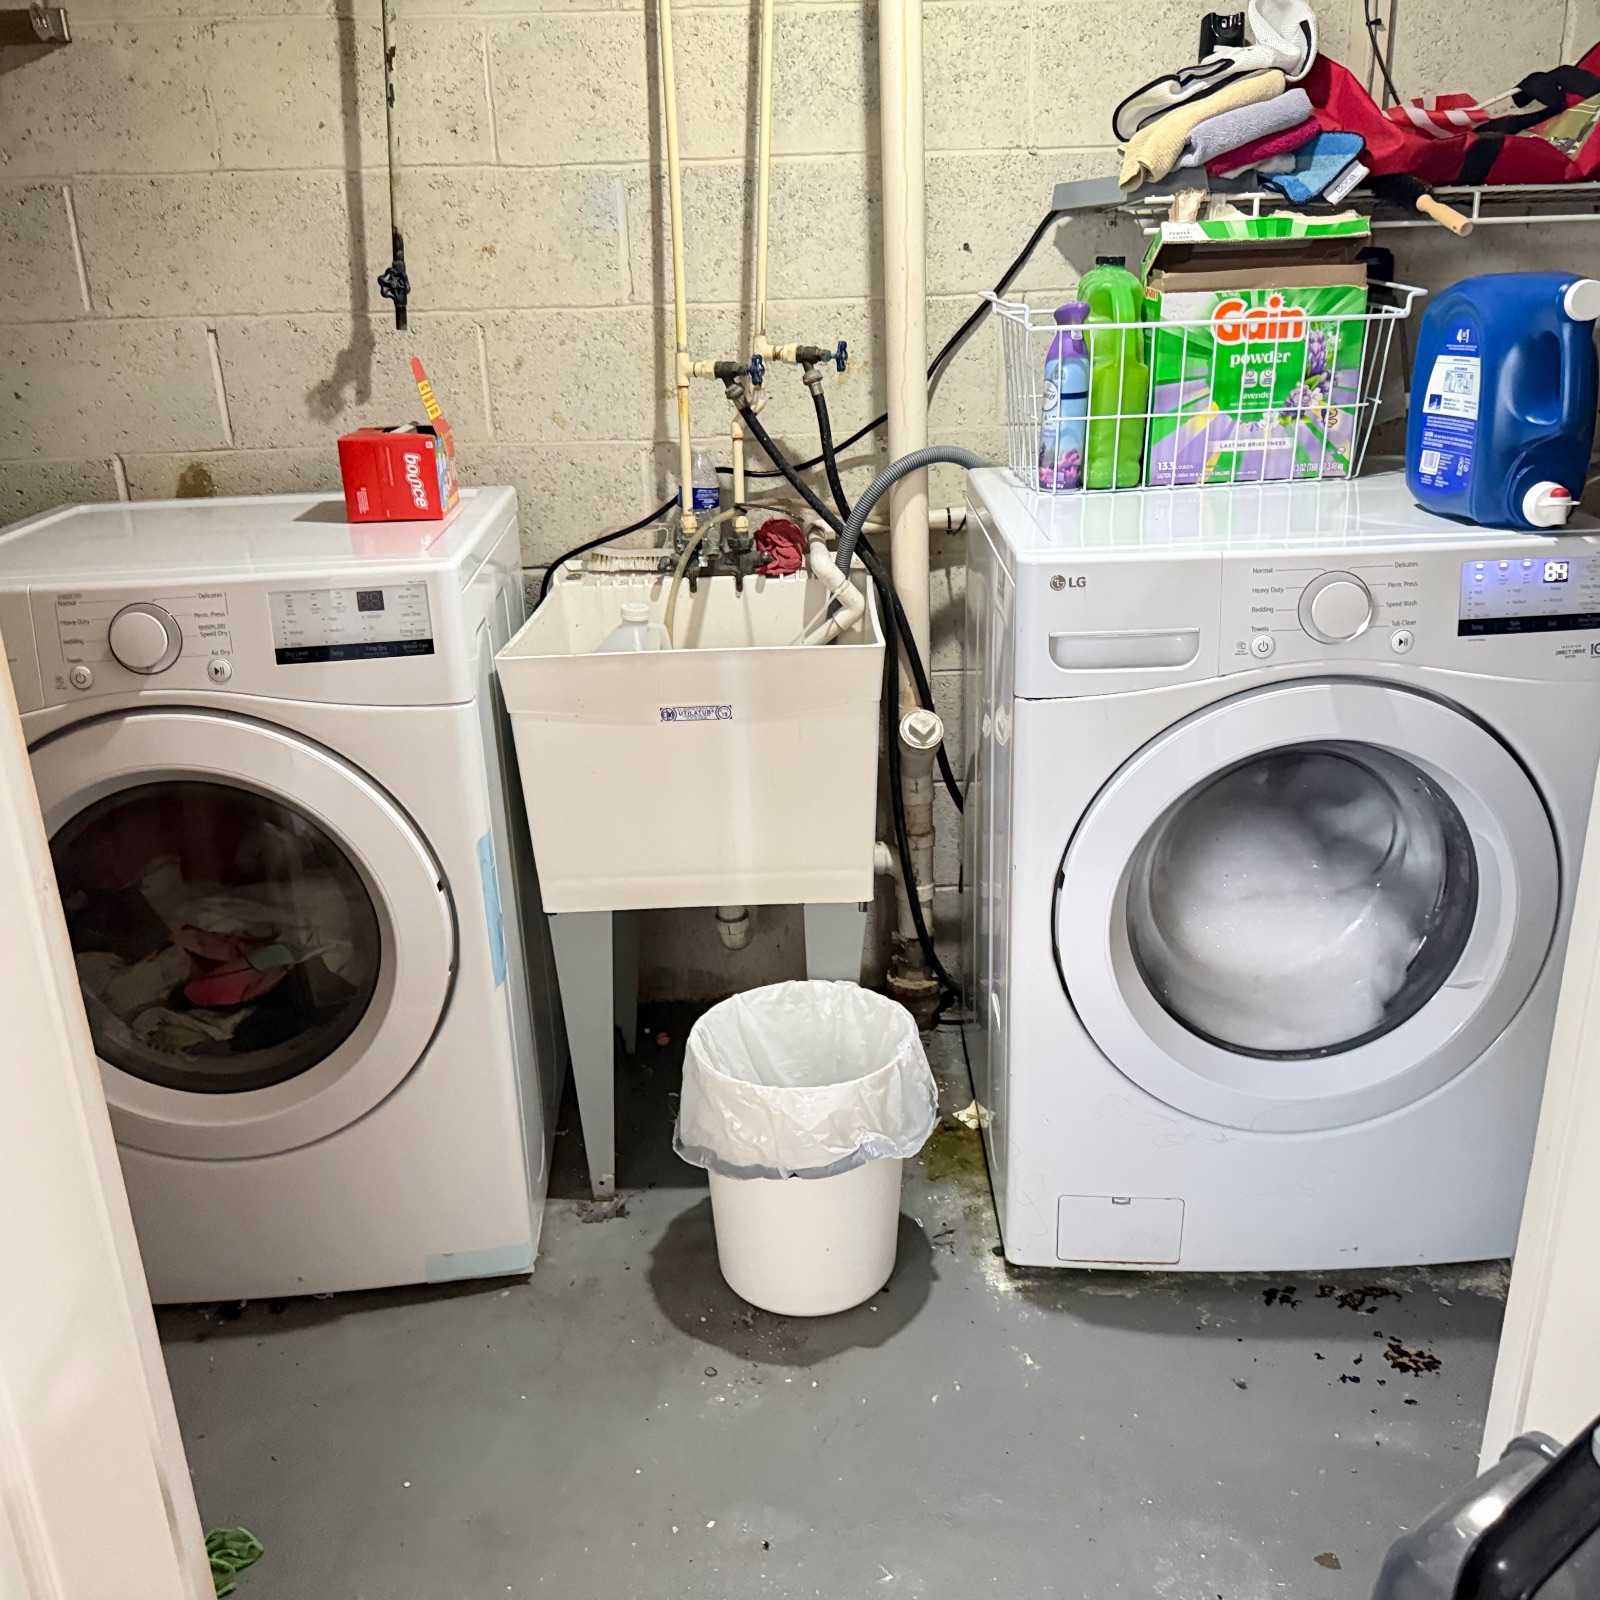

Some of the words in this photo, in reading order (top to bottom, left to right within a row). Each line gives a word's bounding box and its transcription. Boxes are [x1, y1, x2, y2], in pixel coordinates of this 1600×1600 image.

[1212, 294, 1304, 343] Gain
[1229, 351, 1291, 368] powder
[1241, 390, 1274, 400] avende
[1157, 461, 1174, 471] 133
[403, 452, 429, 510] bounce
[1068, 576, 1087, 588] LG
[1270, 586, 1284, 594] Duty
[1251, 606, 1274, 614] Bedding
